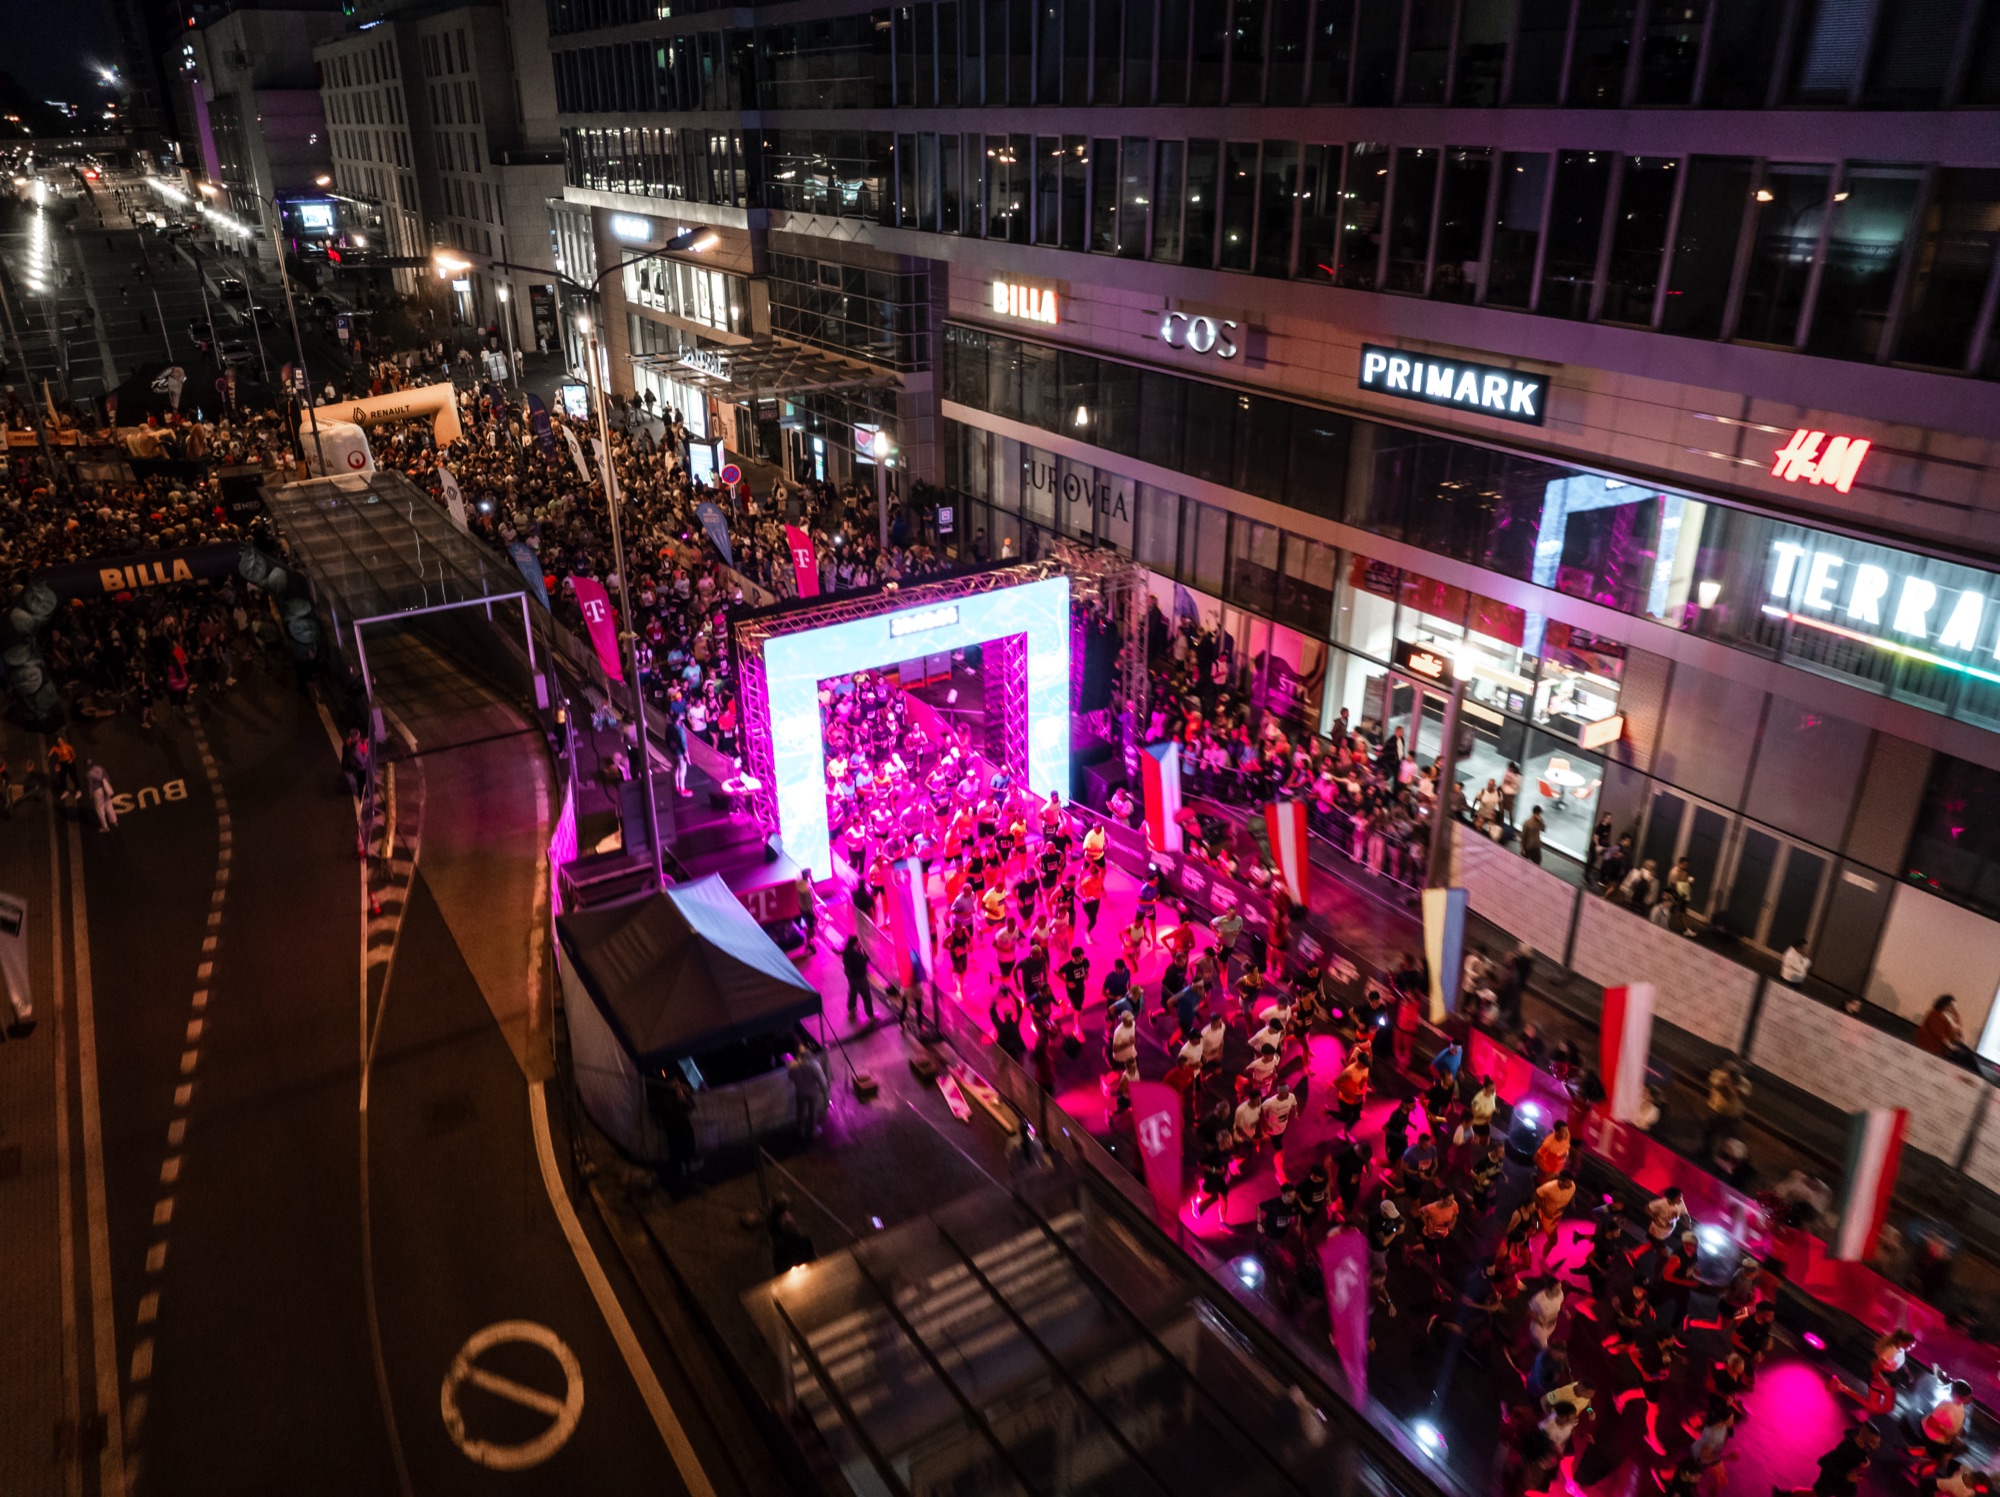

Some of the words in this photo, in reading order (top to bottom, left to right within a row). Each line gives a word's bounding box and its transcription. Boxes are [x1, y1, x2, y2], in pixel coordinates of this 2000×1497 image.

[992, 280, 1060, 325] BILLA
[1161, 311, 1239, 360] COS
[1363, 352, 1539, 417] PRIMARK
[370, 404, 411, 419] RENAULT
[1770, 428, 1872, 494] H&M
[1025, 458, 1130, 523] UROVEA
[99, 557, 194, 593] BILLA
[1771, 540, 2000, 661] TERRA
[111, 777, 189, 815] BUS
